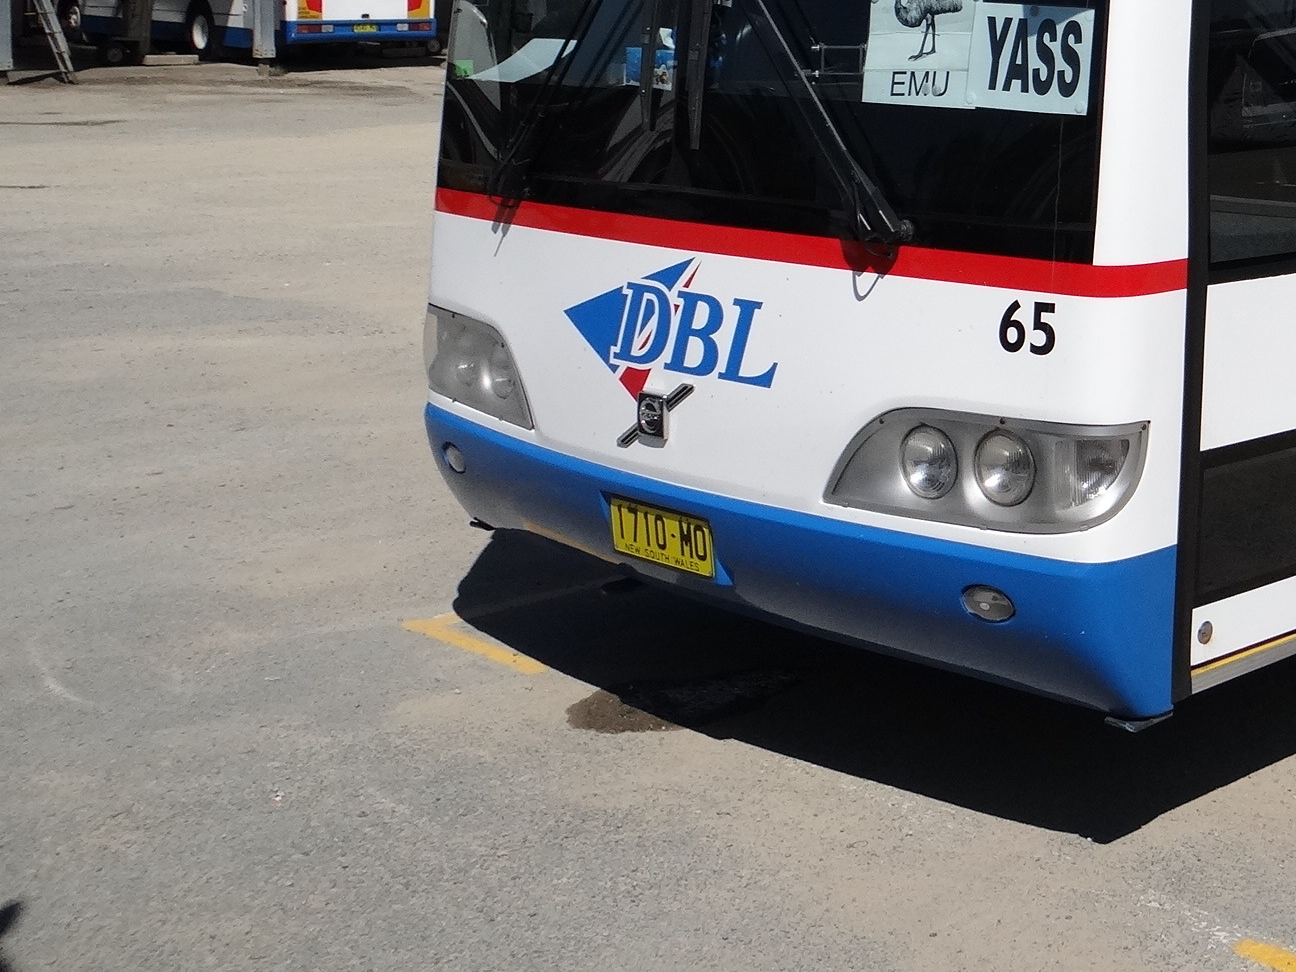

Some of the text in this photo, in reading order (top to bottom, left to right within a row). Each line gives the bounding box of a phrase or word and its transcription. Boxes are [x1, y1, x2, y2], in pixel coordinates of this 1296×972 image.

[890, 70, 949, 97] EMU
[987, 16, 1083, 98] YASS
[613, 282, 778, 388] DBL
[1000, 300, 1056, 355] 65
[625, 543, 700, 572] NEW SOUTH WALES
